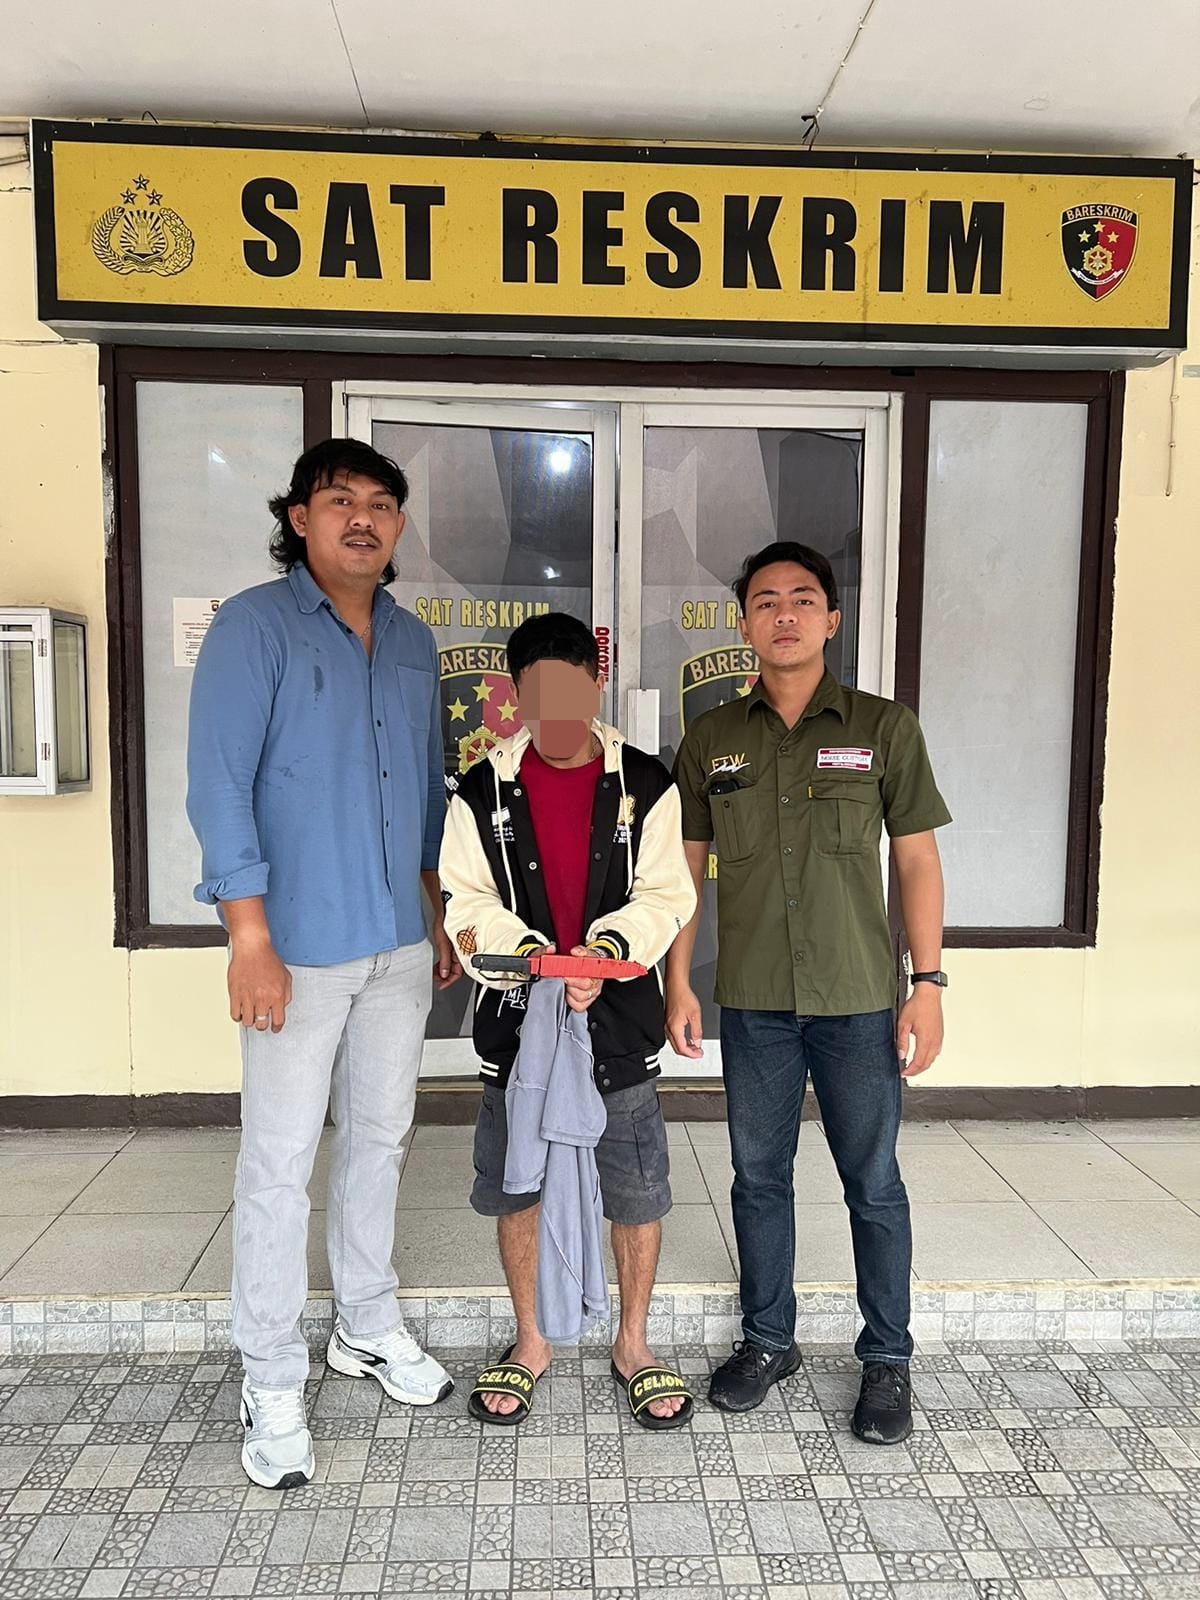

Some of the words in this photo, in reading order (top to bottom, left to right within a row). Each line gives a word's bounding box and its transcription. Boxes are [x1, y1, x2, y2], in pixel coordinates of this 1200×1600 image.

[1066, 205, 1133, 221] BARESKRIM
[241, 177, 446, 281] SAT
[502, 188, 1005, 295] RESKRIM
[416, 597, 452, 625] SAT
[682, 601, 718, 629] SAT
[440, 648, 508, 675] ARESK
[595, 626, 609, 682] DORON
[479, 1371, 532, 1391] CELION
[634, 1374, 685, 1397] CELION
